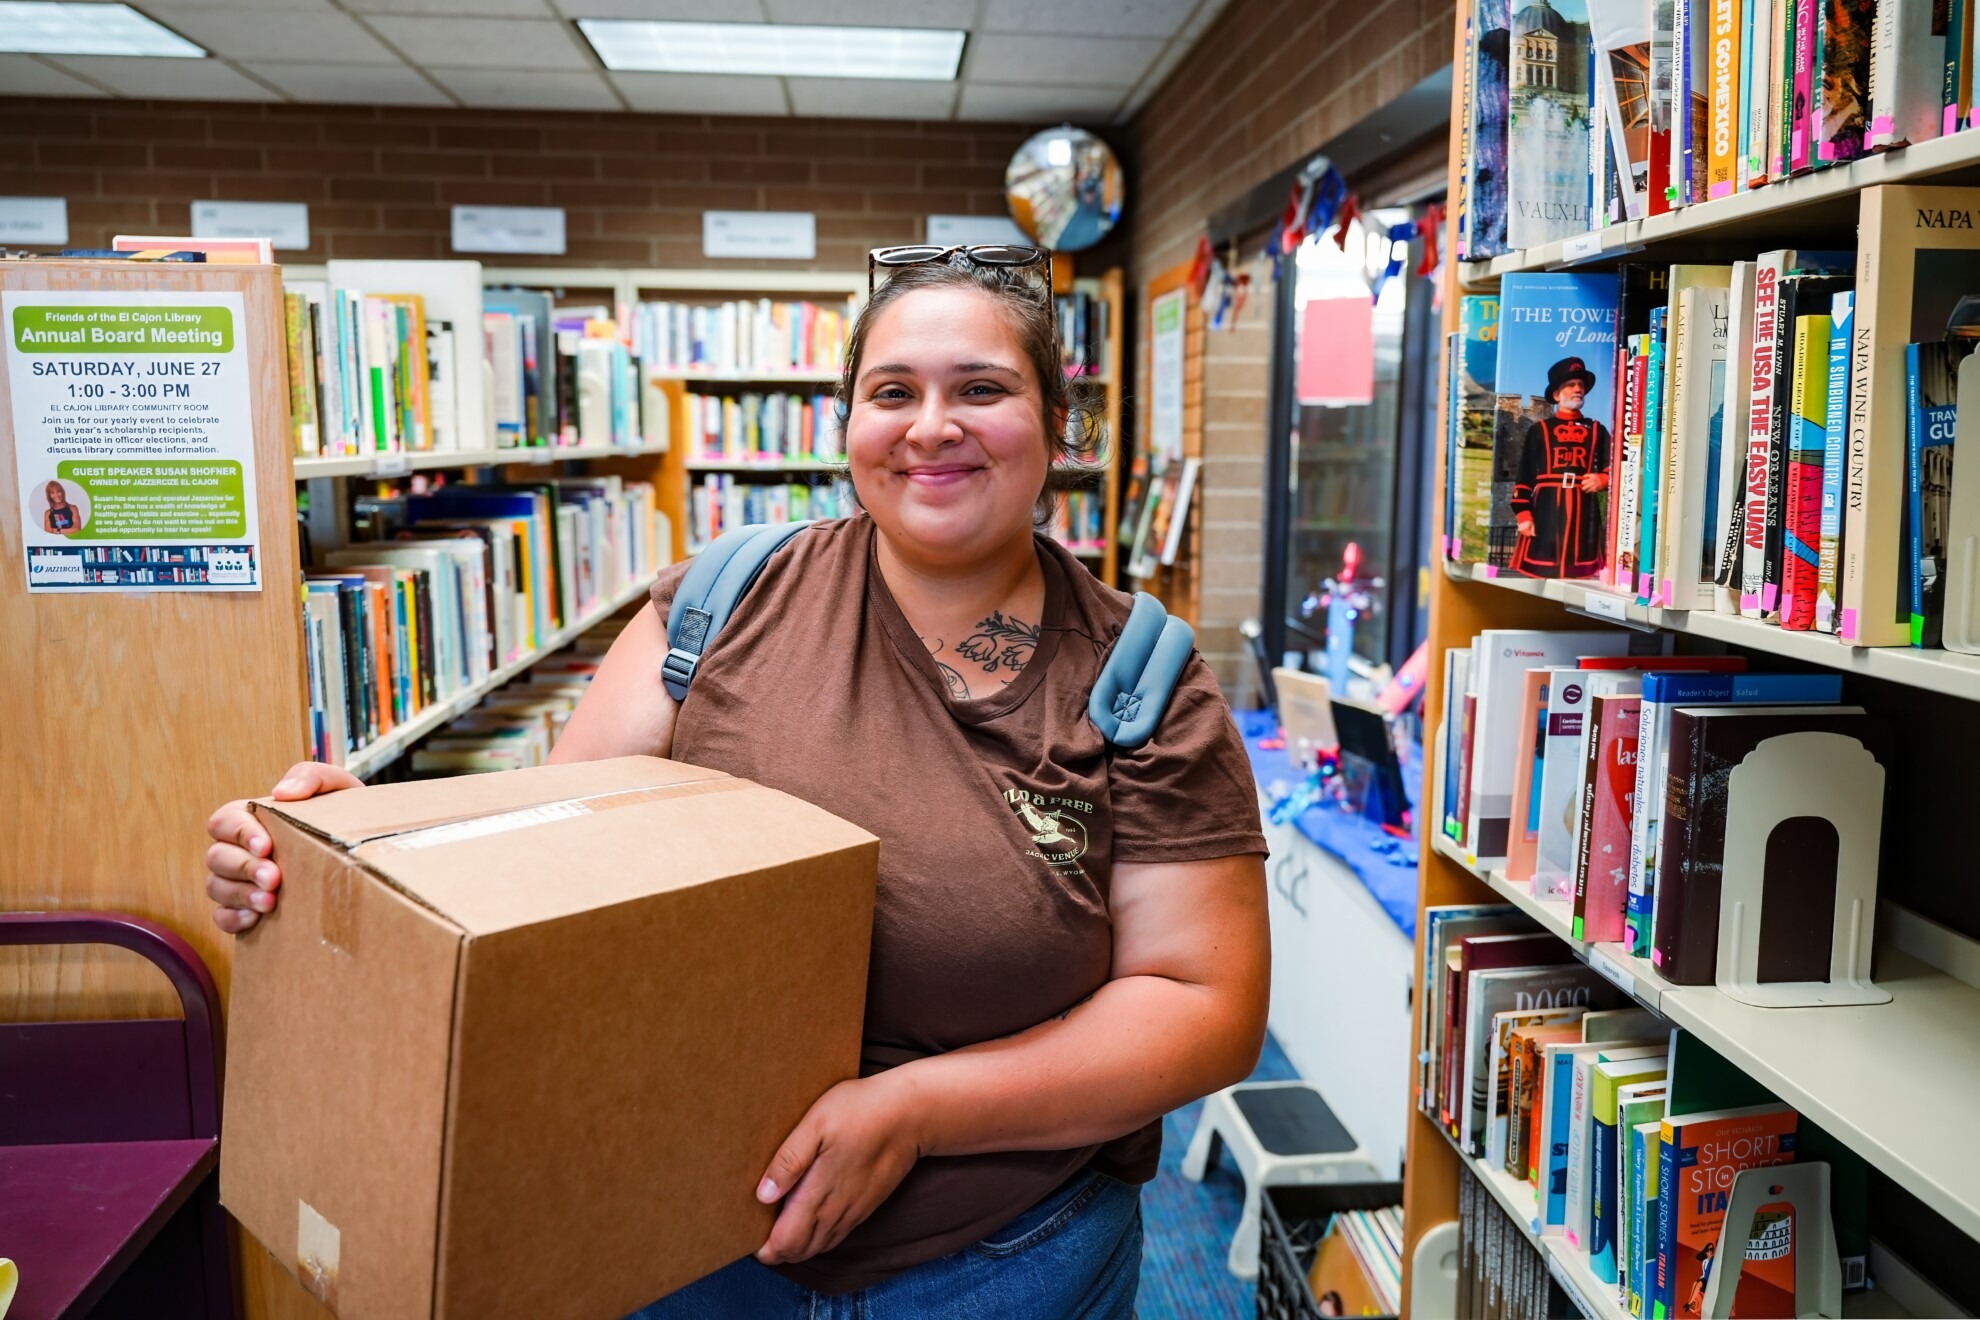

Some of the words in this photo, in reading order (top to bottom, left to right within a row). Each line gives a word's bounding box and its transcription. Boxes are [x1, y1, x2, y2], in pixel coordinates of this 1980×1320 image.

[1916, 208, 1974, 229] NAPA
[1757, 267, 1776, 309] SEE
[45, 312, 84, 322] Friends
[87, 312, 98, 322] of
[100, 312, 116, 322] the
[119, 312, 129, 322] El
[132, 312, 162, 324] Cajon
[164, 312, 201, 324] Library
[1512, 307, 1553, 323] THE
[1757, 309, 1775, 344] THE
[1777, 298, 1787, 336] STUART
[21, 327, 86, 343] Annual
[91, 327, 145, 343] Board
[151, 327, 223, 346] Meeting
[1555, 326, 1577, 347] of
[1797, 331, 1806, 379] ROADSIDE
[1832, 337, 1847, 350] IN
[1856, 328, 1871, 373] NAPA
[32, 361, 141, 378] SATURDAY,
[146, 361, 195, 376] JUNE
[201, 361, 221, 376] 27
[1675, 355, 1684, 402] PEAKS
[1752, 346, 1773, 392] USA
[1775, 350, 1783, 376] LYNN
[67, 383, 104, 398] 1:00
[121, 383, 157, 398] 3:00
[163, 383, 190, 398] PM
[1633, 360, 1643, 412] Frommer's
[1646, 350, 1657, 429] AUCKLAND
[1795, 381, 1803, 427] GEOLOGY
[1827, 366, 1845, 433] SUNBURNED
[1853, 377, 1868, 424] WINE
[41, 416, 62, 424] Join
[77, 416, 91, 424] for
[110, 416, 137, 426] yearly
[166, 416, 176, 424] to
[178, 416, 220, 424] celebrate
[54, 426, 72, 434] this
[74, 426, 102, 436] year's
[104, 426, 156, 436] scholarship
[158, 426, 206, 435] recipients,
[1750, 395, 1771, 437] THE
[1771, 404, 1783, 444] NEW
[46, 446, 82, 454] discuss
[84, 446, 113, 455] library
[116, 446, 163, 454] committee
[165, 446, 219, 454] information.
[53, 436, 101, 445] participate
[104, 436, 113, 444] in
[115, 436, 143, 444] officer
[146, 436, 189, 445] elections,
[191, 436, 208, 444] and
[1825, 435, 1842, 486] COUNTRY
[72, 468, 105, 476] GUEST
[107, 467, 153, 476] SPEAKER
[155, 467, 188, 476] SUSAN
[190, 467, 237, 476] SHOFNER
[1628, 451, 1637, 485] New
[1668, 432, 1679, 495] PRAIRIES
[1748, 441, 1768, 497] EASY
[1850, 428, 1866, 513] COUNTRY
[1767, 450, 1781, 527] ORLEANS
[1789, 466, 1799, 533] YELLOWSTONE
[1624, 488, 1636, 547] Orleans
[1745, 500, 1766, 550] WAY
[1822, 514, 1838, 537] BILL
[1786, 535, 1795, 580] COUNTRY
[1818, 541, 1836, 584] BRYSON
[1707, 689, 1730, 698] Digest
[1735, 689, 1760, 697] Salud
[1638, 708, 1651, 763] Soluciones
[1049, 797, 1093, 813] FREE
[1635, 765, 1645, 814] naturales
[1633, 814, 1641, 831] para
[1630, 843, 1643, 889] diabetes
[1702, 1135, 1775, 1164] SHORT
[1660, 1165, 1670, 1202] SHORT
[1659, 1202, 1669, 1242] STORIES
[1657, 1252, 1667, 1288] ITALIAN
